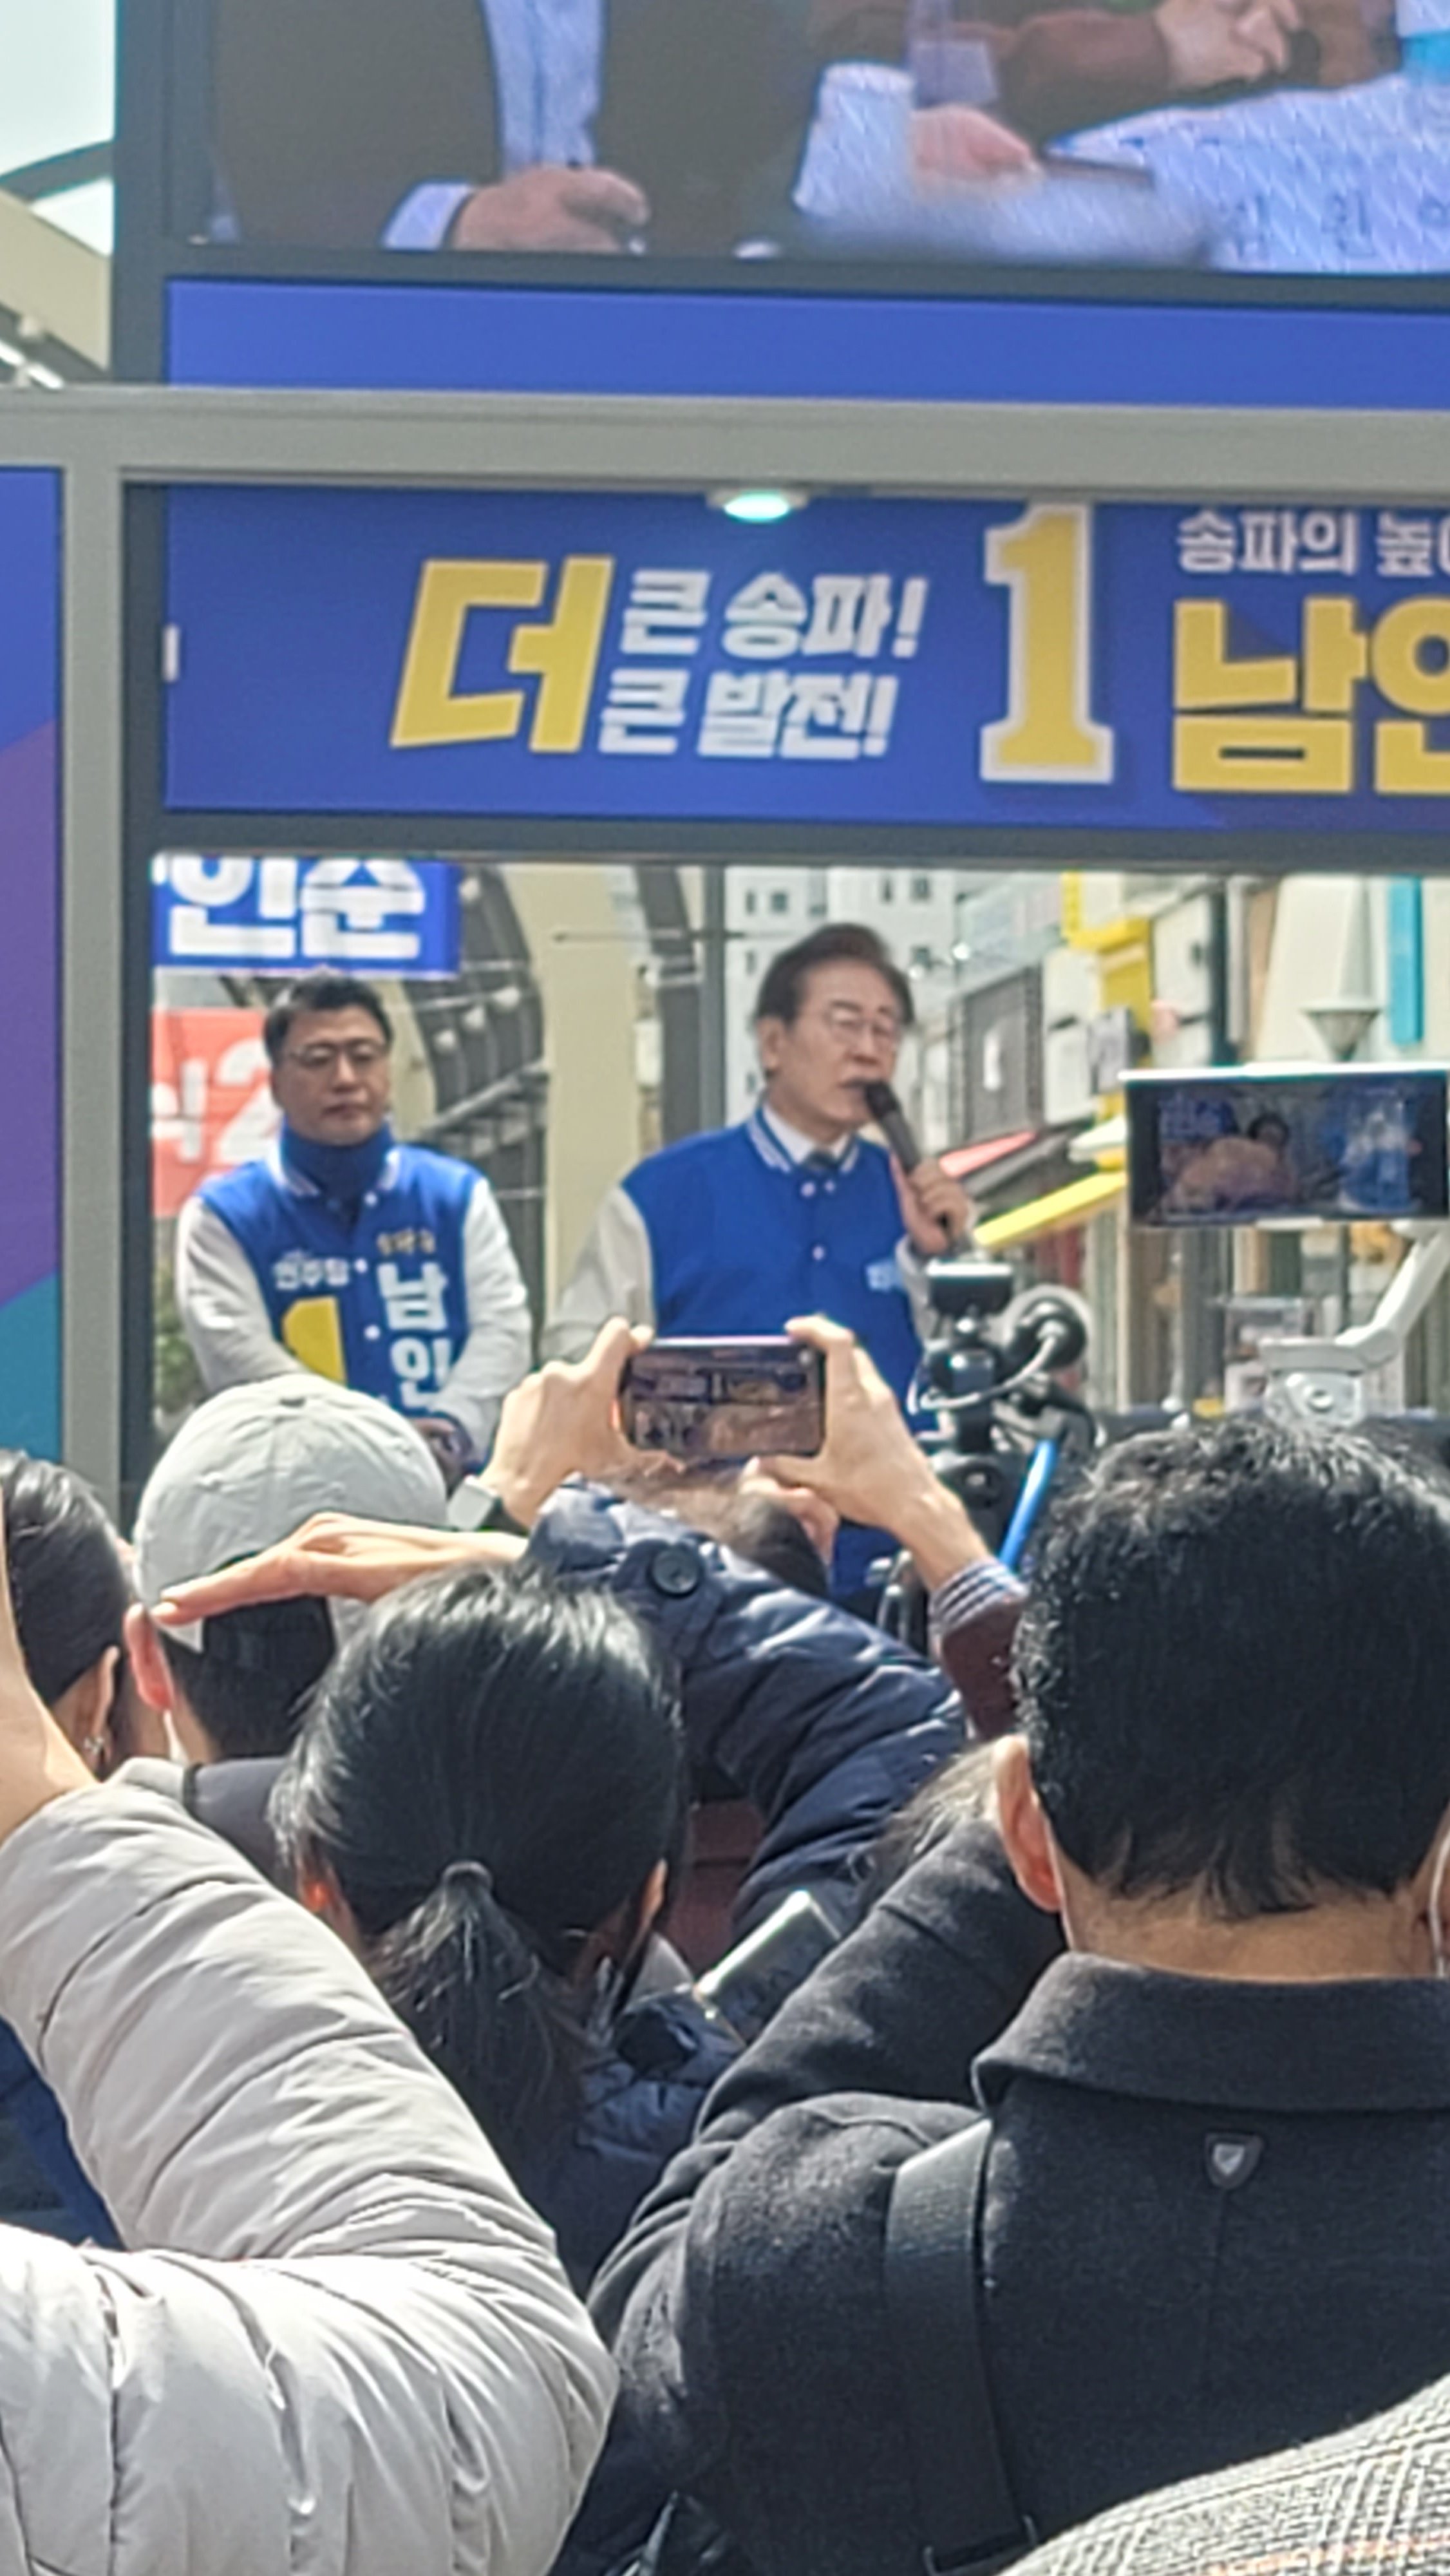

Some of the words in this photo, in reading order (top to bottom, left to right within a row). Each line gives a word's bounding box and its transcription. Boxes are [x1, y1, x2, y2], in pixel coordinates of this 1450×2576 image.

[1177, 509, 1357, 574] 송파의
[1377, 512, 1450, 578] 높
[390, 556, 615, 752] 더
[620, 571, 711, 654] 큰
[722, 572, 928, 658] 송파!
[980, 502, 1114, 784] 1
[598, 668, 690, 753] 큰
[697, 670, 899, 759] 발전!
[153, 855, 426, 959] 인순
